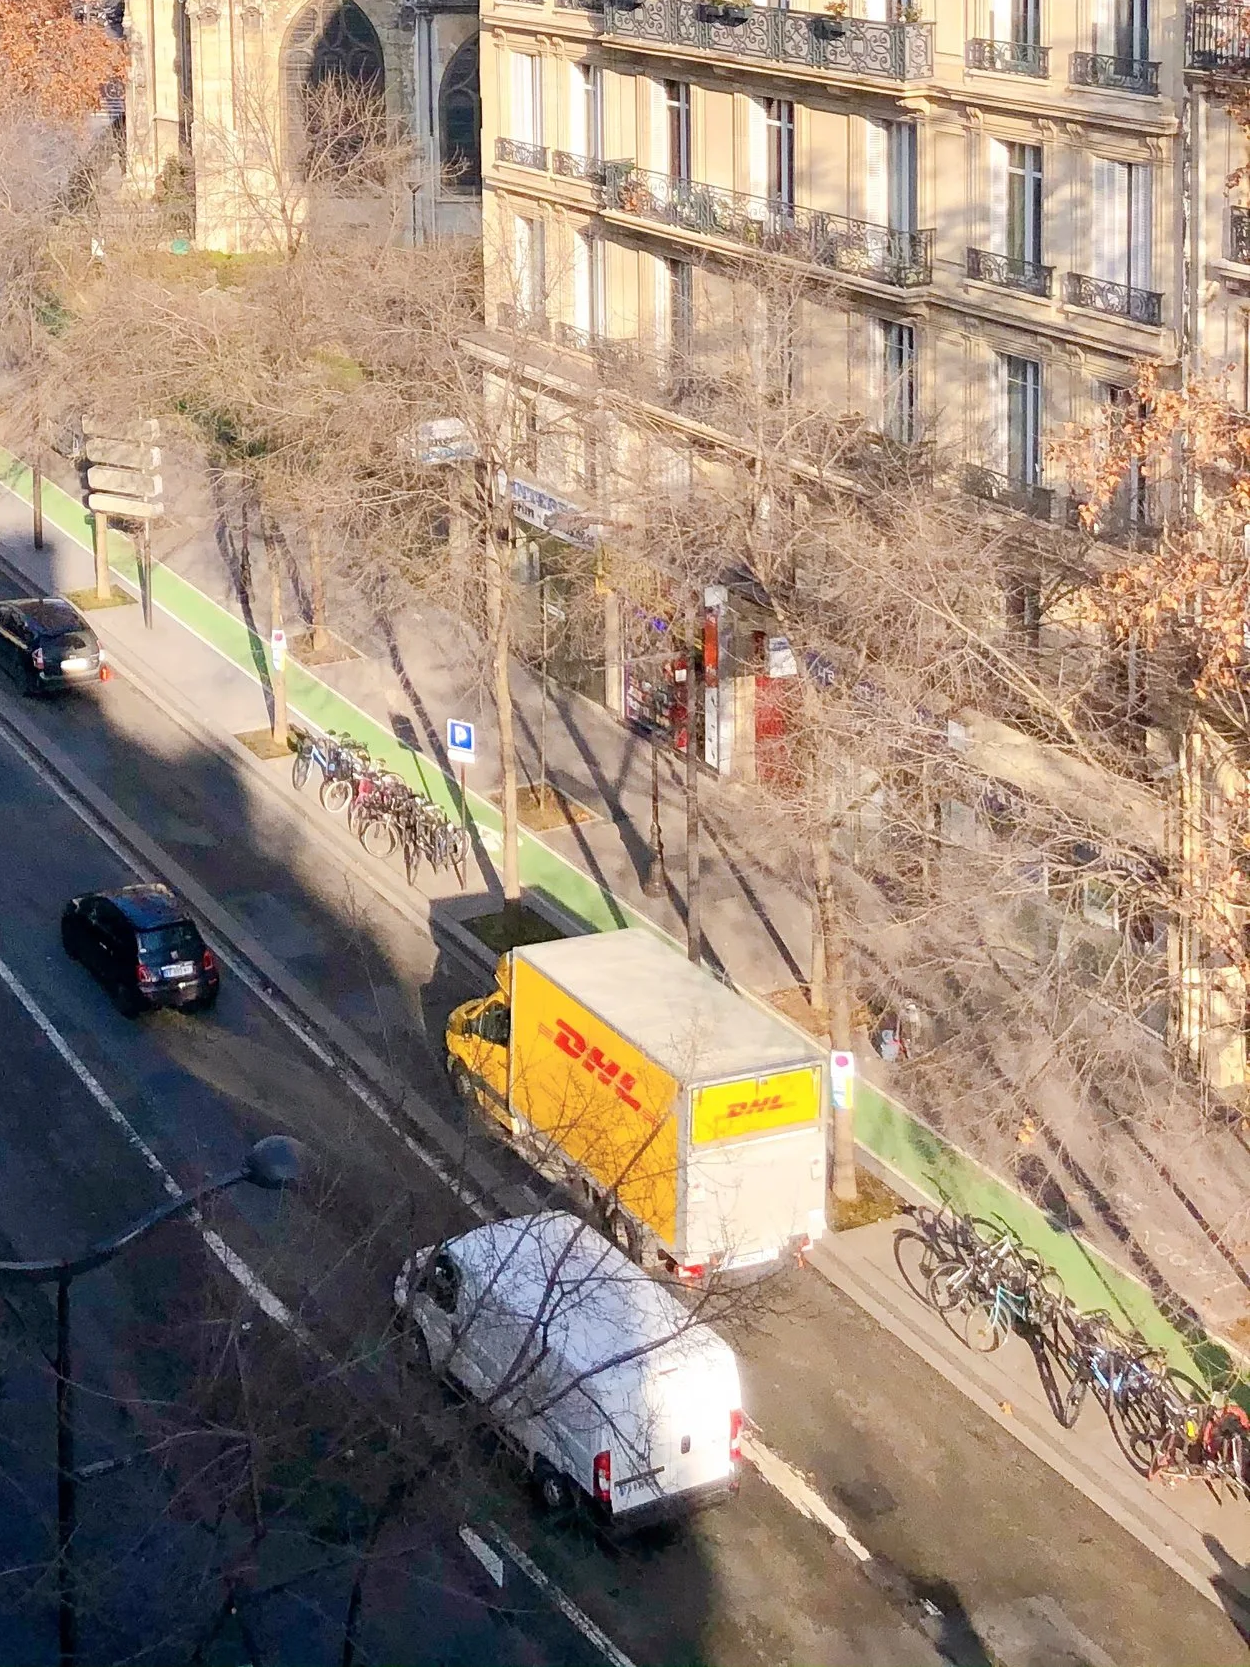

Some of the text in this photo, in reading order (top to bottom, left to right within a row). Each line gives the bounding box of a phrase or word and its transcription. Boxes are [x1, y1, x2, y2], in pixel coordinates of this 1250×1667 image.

[454, 725, 468, 744] P
[554, 1018, 642, 1112] DHL
[726, 1094, 784, 1118] DHL
